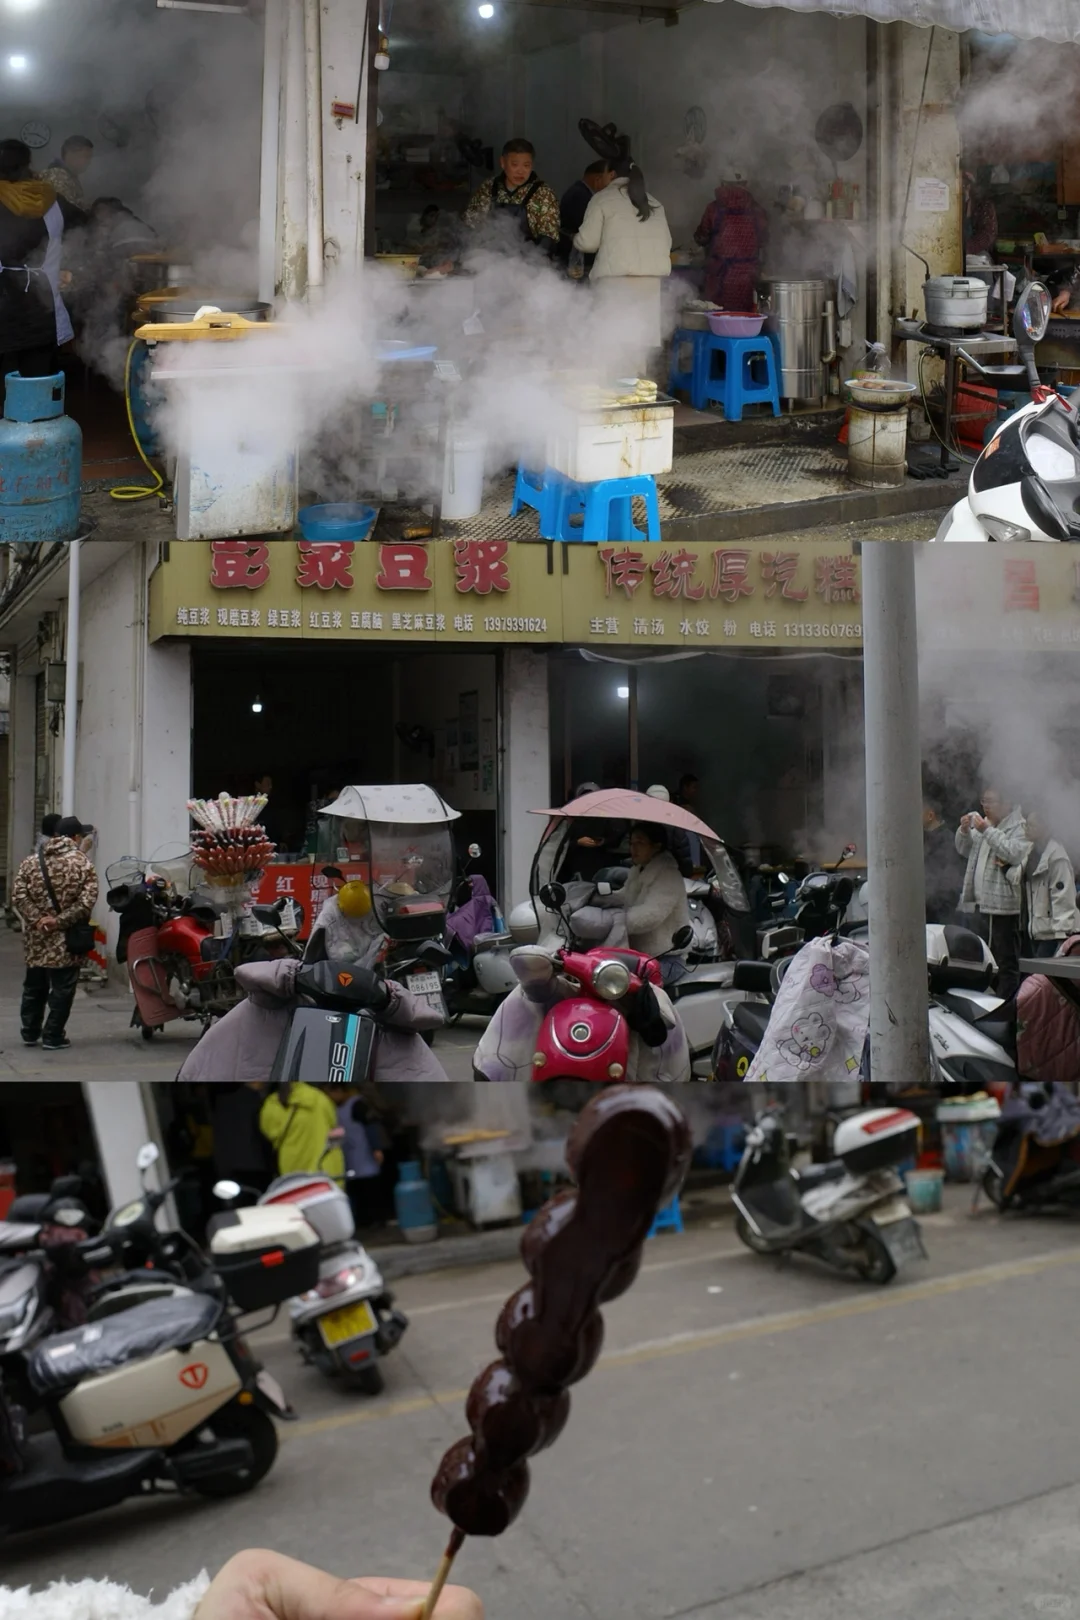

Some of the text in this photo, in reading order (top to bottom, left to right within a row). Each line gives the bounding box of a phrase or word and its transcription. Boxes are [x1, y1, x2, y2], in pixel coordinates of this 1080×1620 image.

[177, 607, 548, 633] 纯豆浆 现磨豆浆 绿豆浆 红豆浆 豆腐脑 黑芝麻豆浆 电话 13979391624
[590, 617, 620, 635] 主营
[633, 617, 666, 635] 清汤
[680, 618, 710, 636] 水饺
[723, 619, 738, 637] 粉
[750, 620, 777, 637] 电话
